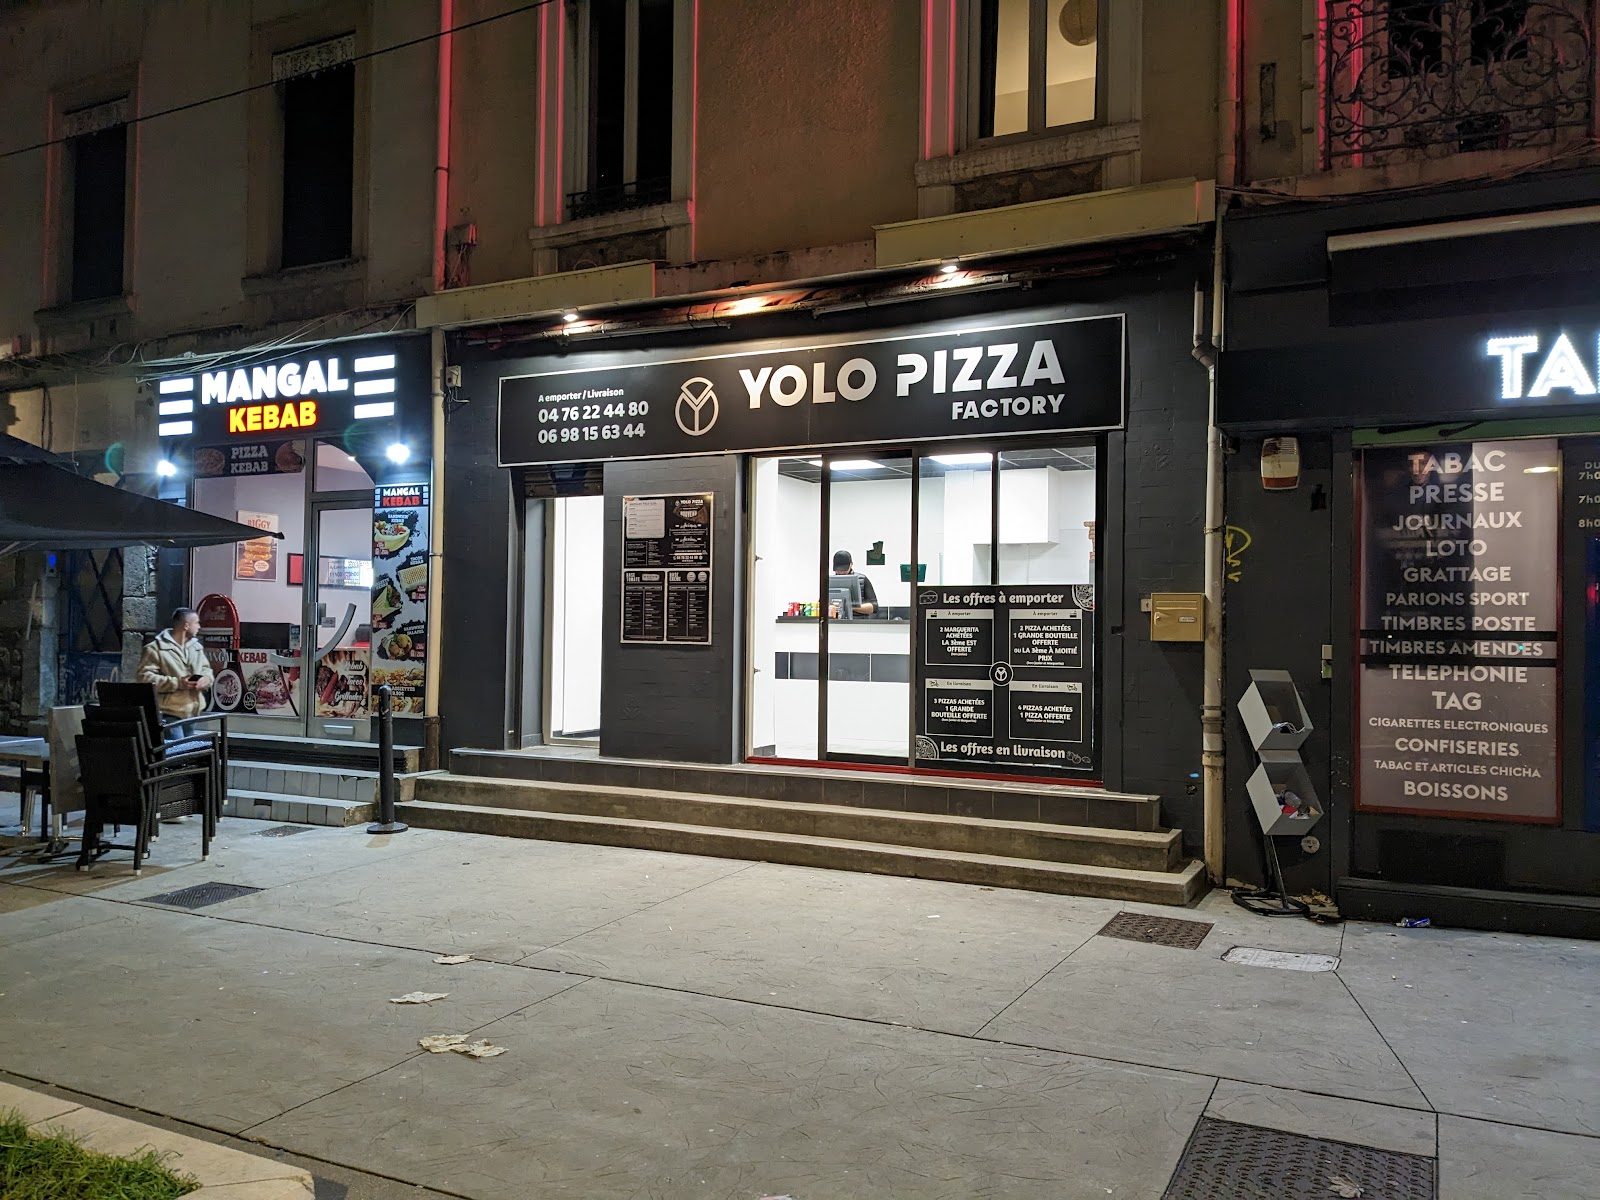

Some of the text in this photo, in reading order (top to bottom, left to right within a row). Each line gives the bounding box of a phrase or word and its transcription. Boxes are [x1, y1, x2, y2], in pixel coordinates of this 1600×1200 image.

[739, 339, 1065, 409] YOLO PIZZA
[1487, 333, 1600, 398] TA
[201, 358, 348, 404] MANGAL
[545, 390, 582, 403] emporter
[587, 387, 624, 399] Livraison
[538, 401, 649, 423] 04 76 22 44 80
[952, 394, 1065, 420] FACTORY
[229, 401, 317, 433] KEBAB
[538, 423, 645, 443] 06 98 15 63 44
[231, 445, 268, 459] PIZZA
[230, 461, 268, 474] KEBAB
[1408, 450, 1506, 475] TABAC
[383, 487, 420, 496] MANGAL
[1409, 482, 1505, 504] PRESSE
[382, 496, 420, 507] KEBAB
[247, 518, 271, 529] BIGGY
[1393, 511, 1522, 531] JOURNAUX
[1426, 539, 1487, 557] LOTO
[1403, 566, 1511, 582] GRATTAGE
[943, 591, 1064, 606] Les offres à emporter
[1386, 592, 1530, 606] PARIONS SPORT
[1381, 616, 1535, 631] TIMBRES POSTE
[1055, 646, 1078, 654] MOITIÉ
[1370, 640, 1543, 656] TIMBRES AMENDES
[239, 652, 268, 664] KEBAB
[1389, 664, 1527, 683] TELEPHONIE
[957, 698, 985, 706] ACHETÉES
[1431, 691, 1482, 710] TAG
[1369, 717, 1548, 733] CIGARETTES ELECTRONIQUES
[941, 741, 1066, 758] Les offres en livraison
[1395, 738, 1520, 757] CONFISERIES
[1374, 760, 1541, 778] TABAC ET ARTICLES CHICHA
[1404, 781, 1508, 801] BOISSONS
